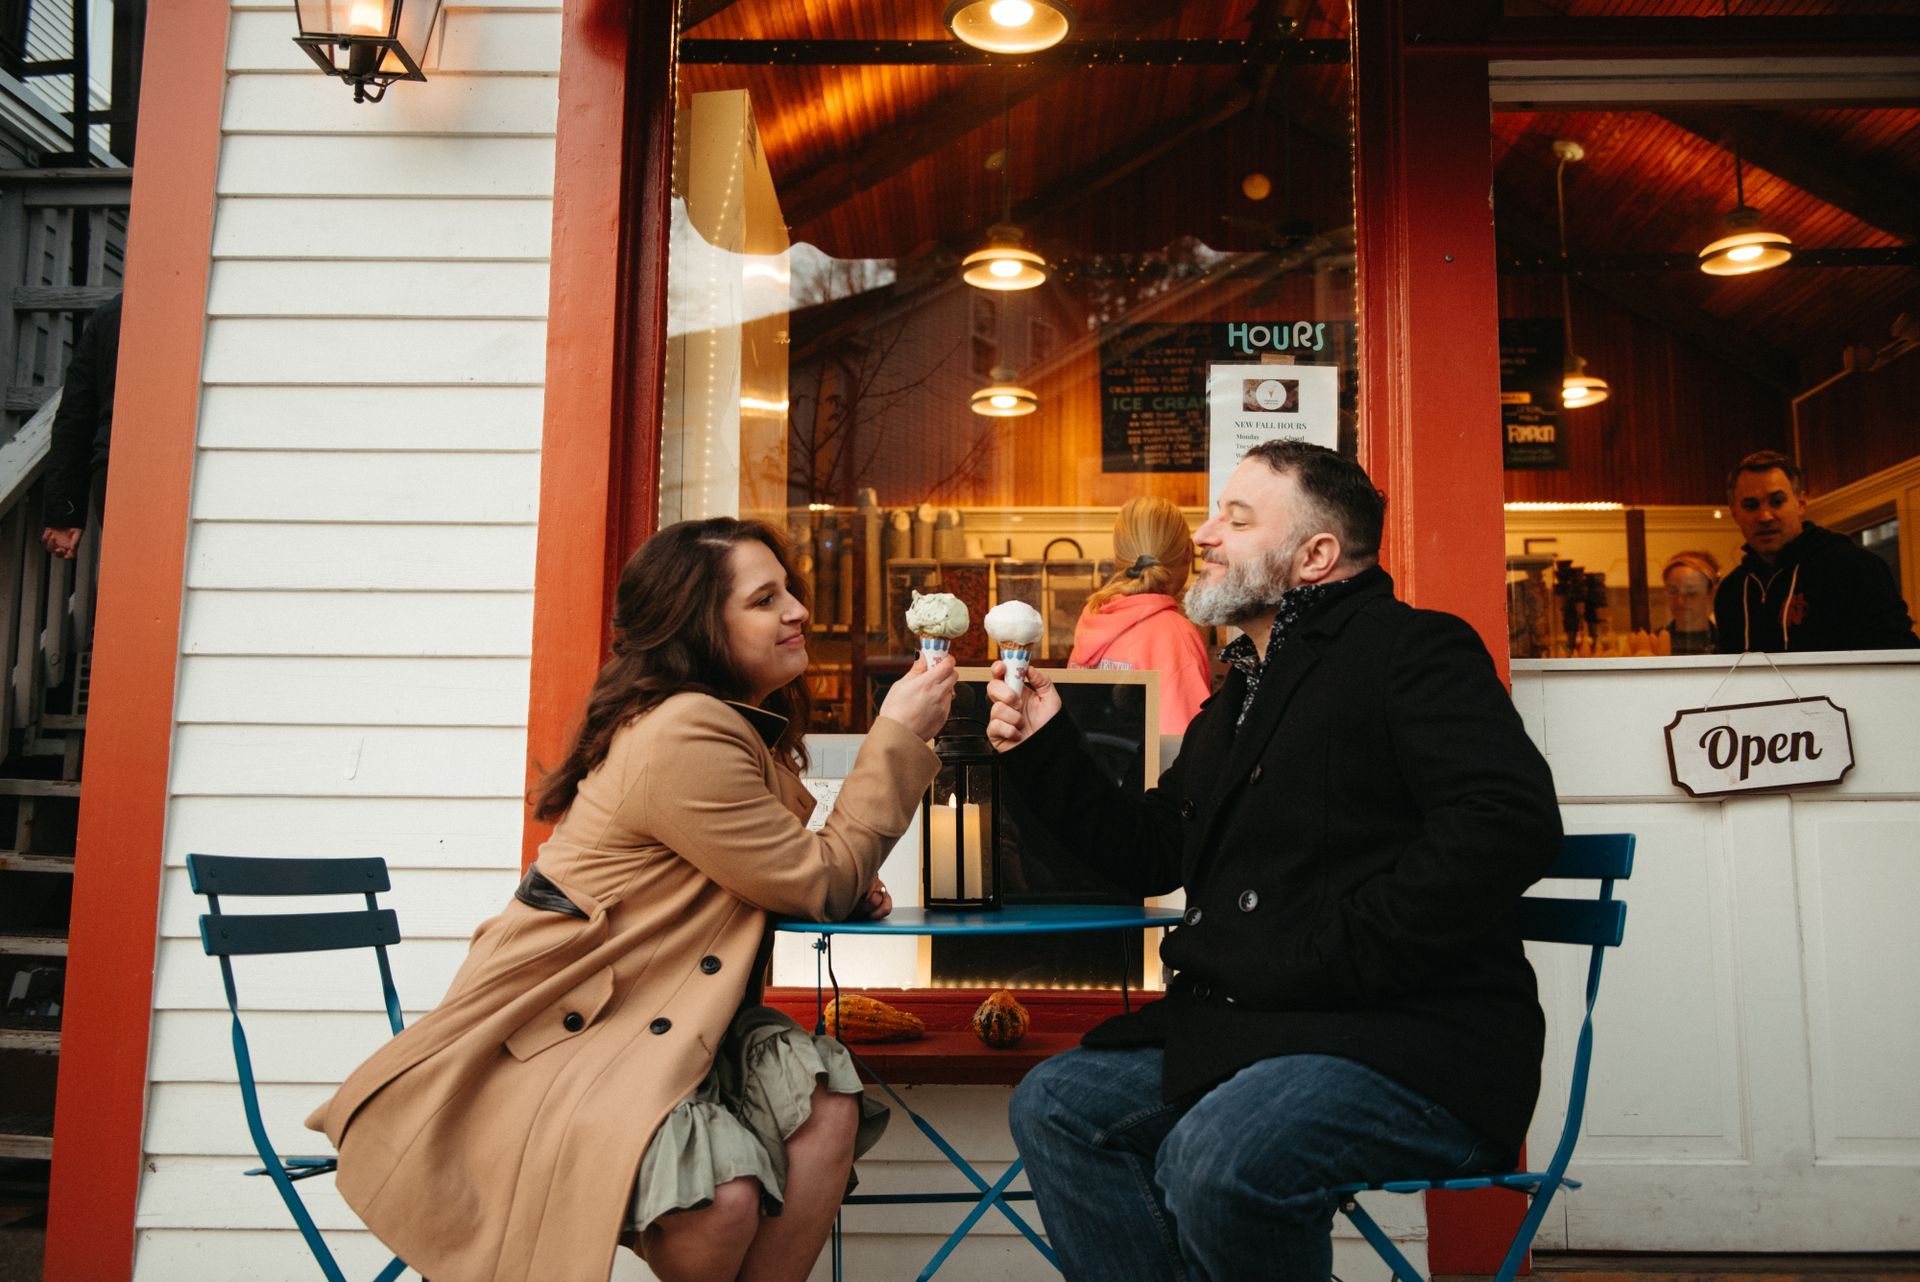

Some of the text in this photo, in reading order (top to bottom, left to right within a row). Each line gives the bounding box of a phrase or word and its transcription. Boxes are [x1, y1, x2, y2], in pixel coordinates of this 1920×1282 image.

[1228, 321, 1325, 354] HOURS
[1112, 396, 1143, 411] ICE
[1234, 421, 1307, 430] NEW FALL HOURS
[1698, 726, 1823, 781] Open
